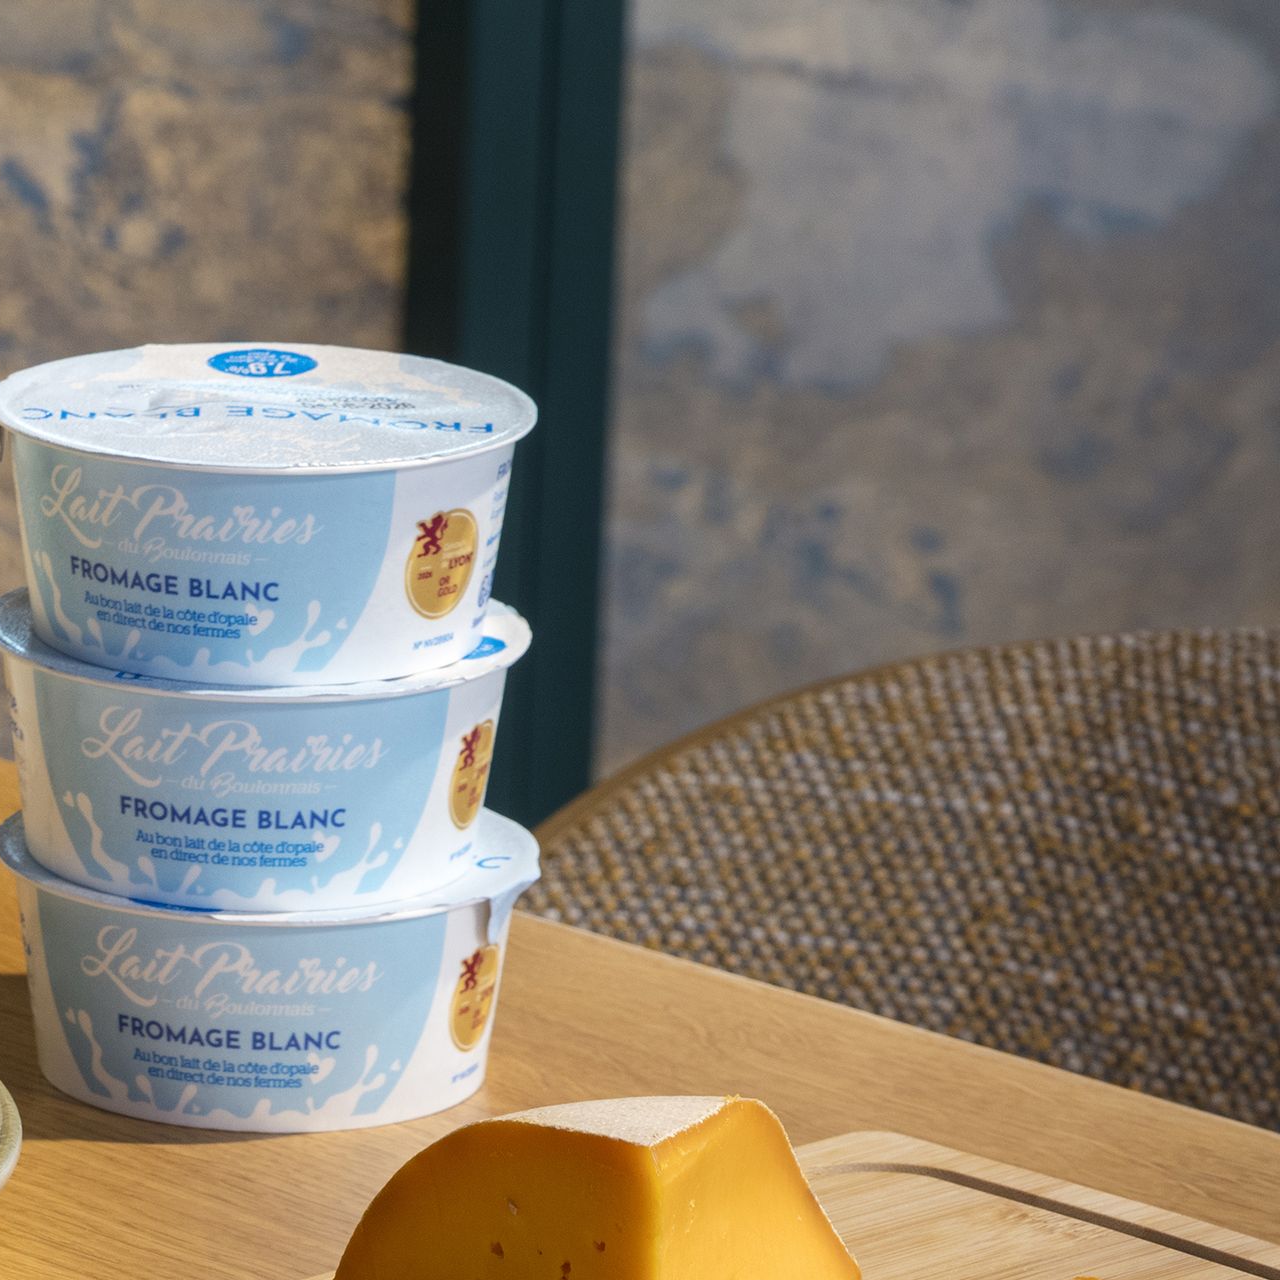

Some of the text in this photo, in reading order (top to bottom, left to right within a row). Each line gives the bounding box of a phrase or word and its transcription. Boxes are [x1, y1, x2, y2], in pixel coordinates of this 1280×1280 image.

[40, 464, 326, 549] Lait Prairies
[142, 537, 251, 567] Boulonnais
[69, 555, 280, 602] FROMAGE BLANC
[81, 705, 388, 788] Lait Prairies
[181, 773, 322, 798] du Boulonnais
[120, 795, 347, 831] FROMAGE BLANC
[134, 829, 155, 845] Au
[154, 833, 182, 849] bon
[184, 837, 204, 852] lait
[207, 838, 225, 853] de
[227, 838, 242, 854] la
[243, 839, 274, 855] côte
[151, 847, 308, 869] en direct de nos fermes
[81, 925, 386, 1008] Lait Prairies
[176, 993, 316, 1020] du Boulonnais
[117, 1013, 342, 1052] FROMAGE BLANC
